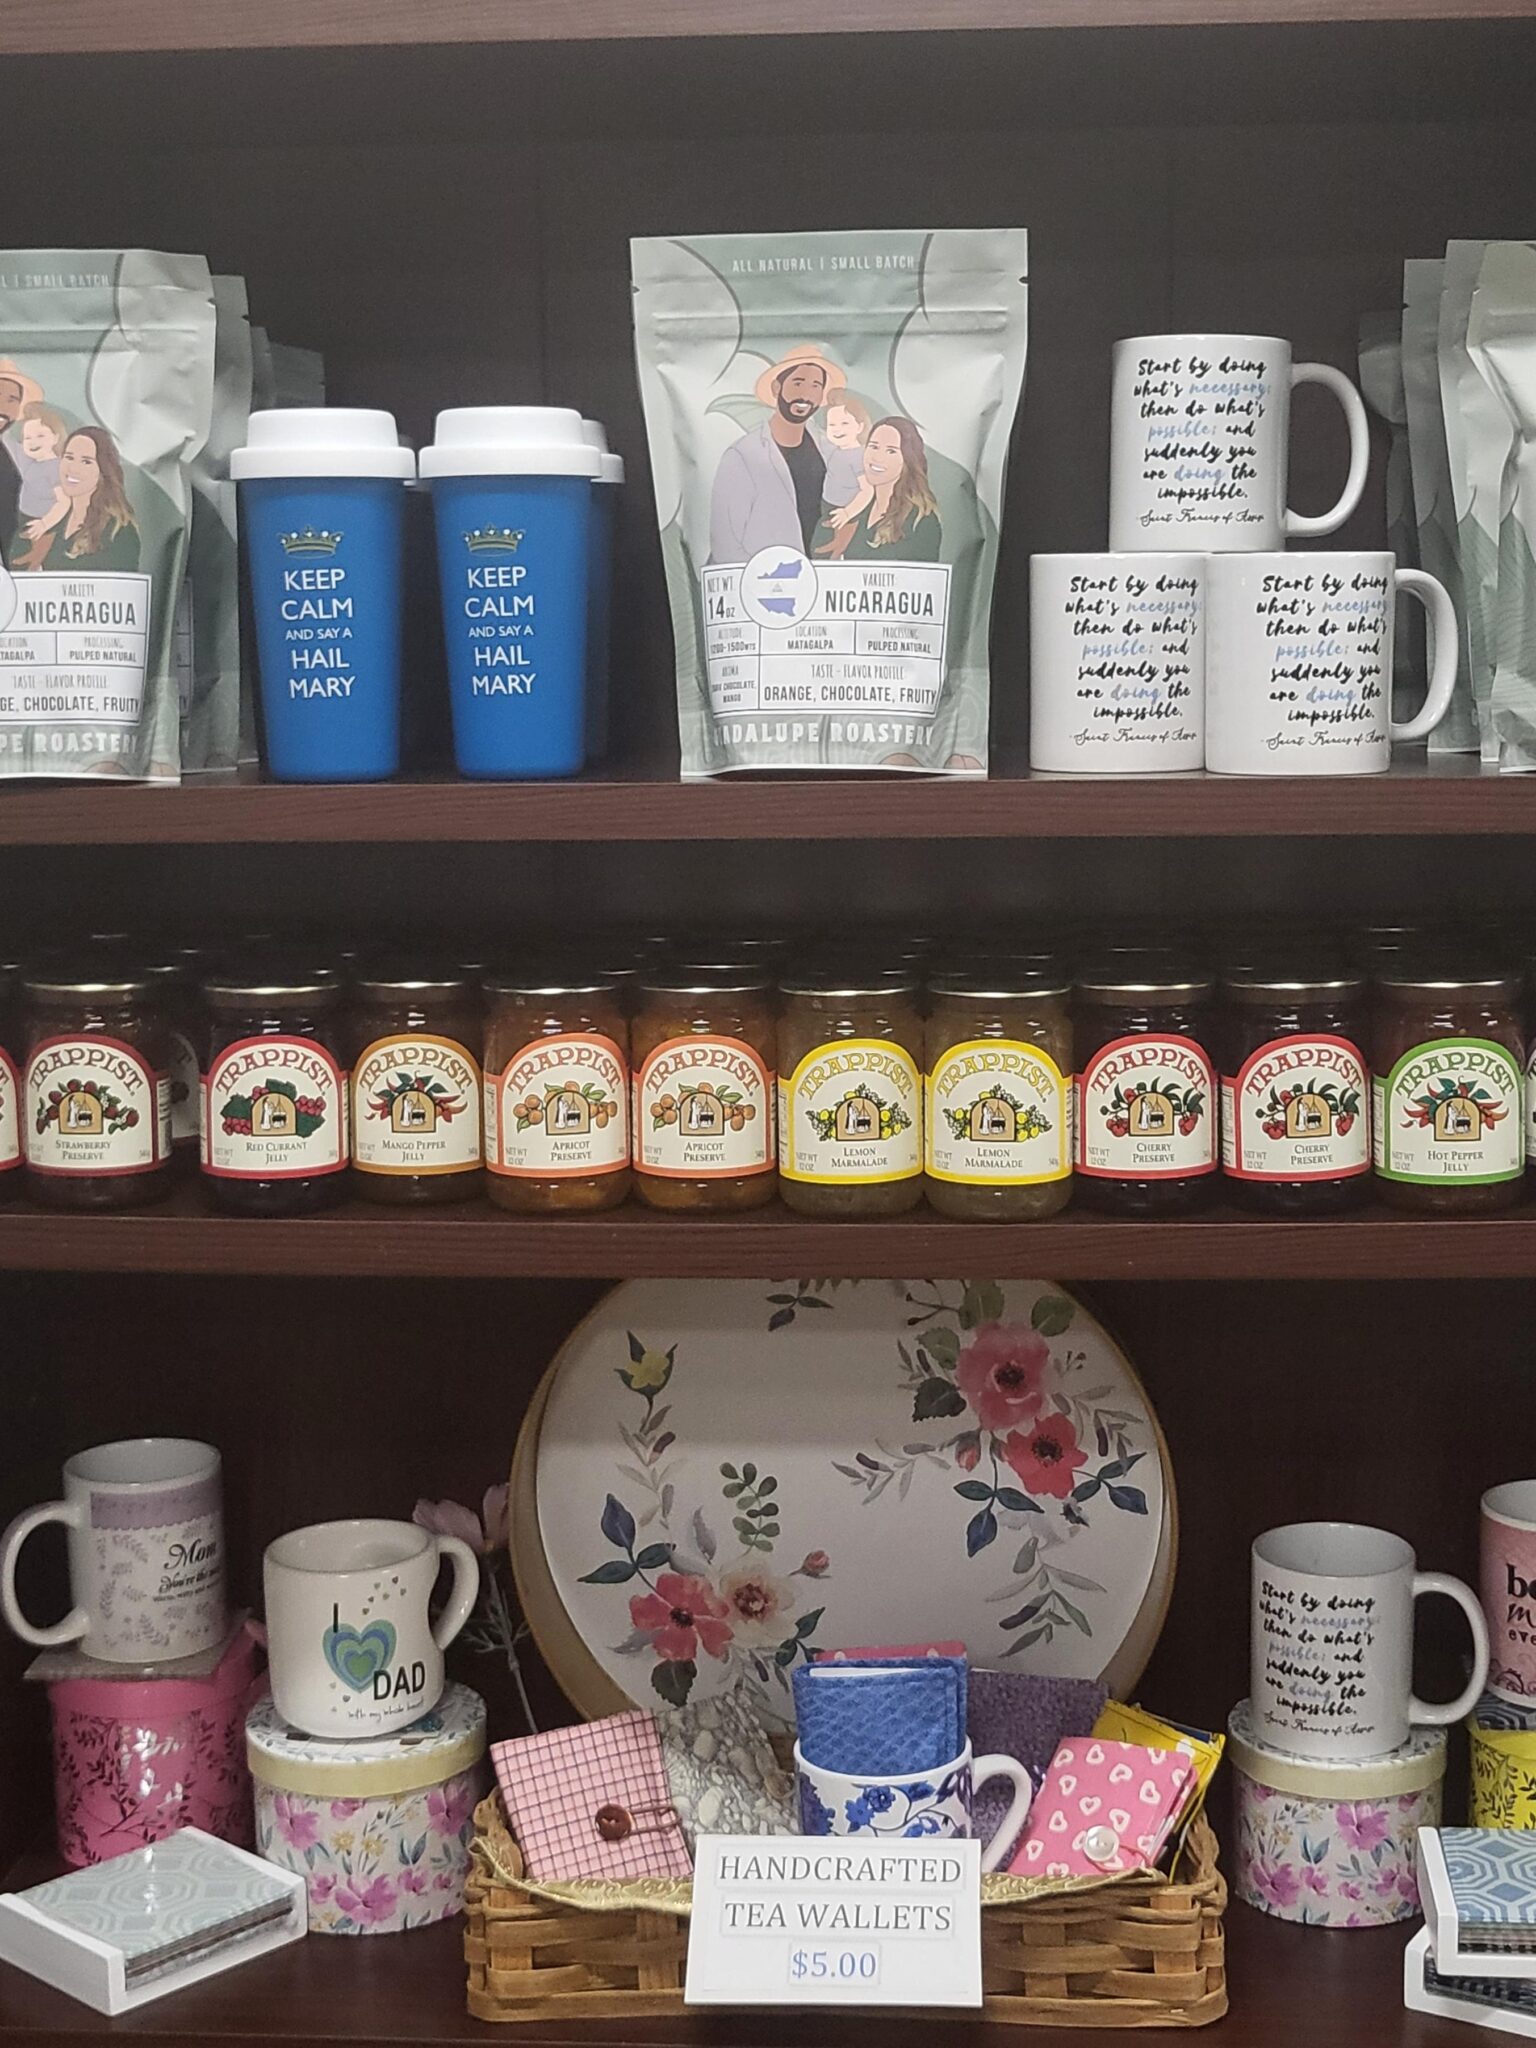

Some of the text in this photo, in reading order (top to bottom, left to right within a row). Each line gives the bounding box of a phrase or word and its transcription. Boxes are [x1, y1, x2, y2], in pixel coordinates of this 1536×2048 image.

[733, 256, 914, 272] ALL NATURAL SMALL BATCH
[1138, 356, 1267, 379] Start by doing
[1134, 380, 1182, 398] what's
[1141, 398, 1265, 418] then do what's
[1225, 421, 1255, 437] and
[1144, 442, 1256, 463] suddenly you
[1143, 463, 1256, 485] are doing the
[1158, 483, 1247, 504] impossible.
[284, 568, 345, 590] KEEP
[467, 566, 526, 588] KEEP
[863, 573, 895, 587] VARIETY
[1071, 575, 1200, 597] Start by doing
[1262, 573, 1388, 596] Start by doing
[62, 584, 95, 597] VARIETY
[25, 602, 136, 625] NICARAGUA
[281, 598, 353, 620] CALM
[465, 595, 534, 618] CALM
[709, 596, 724, 619] 14
[826, 591, 933, 616] NICARAGUA
[1065, 598, 1119, 616] what's
[1256, 597, 1315, 616] what's
[286, 628, 353, 641] AND SAY A
[468, 625, 533, 638] AND SAY A
[1074, 616, 1197, 636] then do what's
[1266, 616, 1387, 637] then do what's
[474, 646, 530, 666] HAIL
[788, 640, 833, 650] MATAGALPA
[868, 641, 931, 653] PULPED NATURAL
[1162, 638, 1189, 655] and
[1357, 638, 1380, 655] and
[70, 651, 136, 662] PULPED NATURAL
[292, 648, 349, 669] HAIL
[812, 665, 904, 679] TASTE FLAVOR PROFILE
[1078, 661, 1190, 683] suddenly you
[1271, 662, 1381, 684] suddenly you
[289, 676, 355, 698] MARY
[472, 674, 536, 695] MARY
[764, 686, 937, 705] ORANGE, CHOCOLATE, FRUITY
[1077, 681, 1190, 703] are doing the
[1270, 682, 1382, 704] are doing the
[24, 697, 99, 712] CHOCOLATE,
[1094, 702, 1182, 724] impossible.
[1288, 705, 1374, 726] impossible.
[831, 723, 932, 745] ROASTERY
[30, 1048, 144, 1093] TRAPPIST
[216, 1049, 333, 1095] TRAPPIST
[360, 1047, 473, 1091] TRAPPIST
[508, 1047, 621, 1095] TRAPPIST
[646, 1049, 760, 1094] TRAPPIST
[799, 1053, 913, 1100] TRAPPIST
[937, 1053, 1055, 1098] TRAPPIST
[1091, 1048, 1207, 1094] TRAPPIST
[1246, 1049, 1362, 1097] TRAPPIST
[1395, 1052, 1514, 1099] TRAPPIST
[164, 1539, 217, 1570] Mom
[1262, 1581, 1375, 1613] Start by doing
[334, 1603, 338, 1633] I
[1260, 1601, 1296, 1624] what's
[1264, 1618, 1374, 1646] then do what's
[1509, 1629, 1536, 1646] eve
[1334, 1648, 1363, 1663] and
[374, 1661, 425, 1700] DAD
[1266, 1657, 1365, 1685] suddenly you
[1266, 1677, 1283, 1689] are
[1341, 1685, 1366, 1700] the
[1277, 1696, 1357, 1716] impossible.
[720, 1856, 961, 1882] HANDCRAFTED
[725, 1903, 950, 1930] TEA WALLETS
[792, 1950, 876, 1978] $5.00
